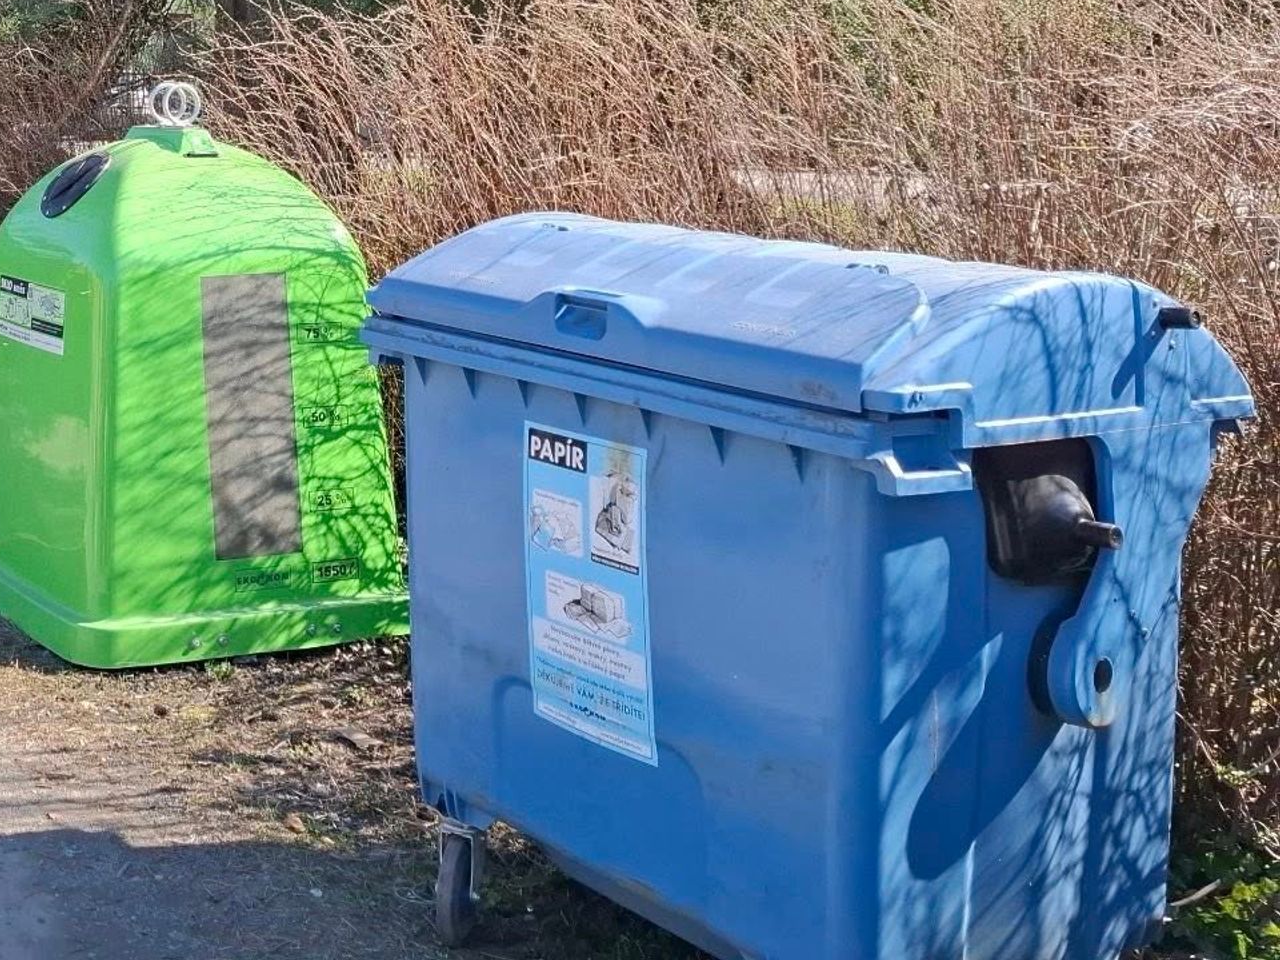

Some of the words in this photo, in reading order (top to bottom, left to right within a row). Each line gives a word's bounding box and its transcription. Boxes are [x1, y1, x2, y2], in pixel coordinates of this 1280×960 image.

[305, 328, 319, 339] 75
[312, 411, 326, 422] 50
[530, 435, 584, 471] PAPÍR
[317, 495, 332, 506] 25
